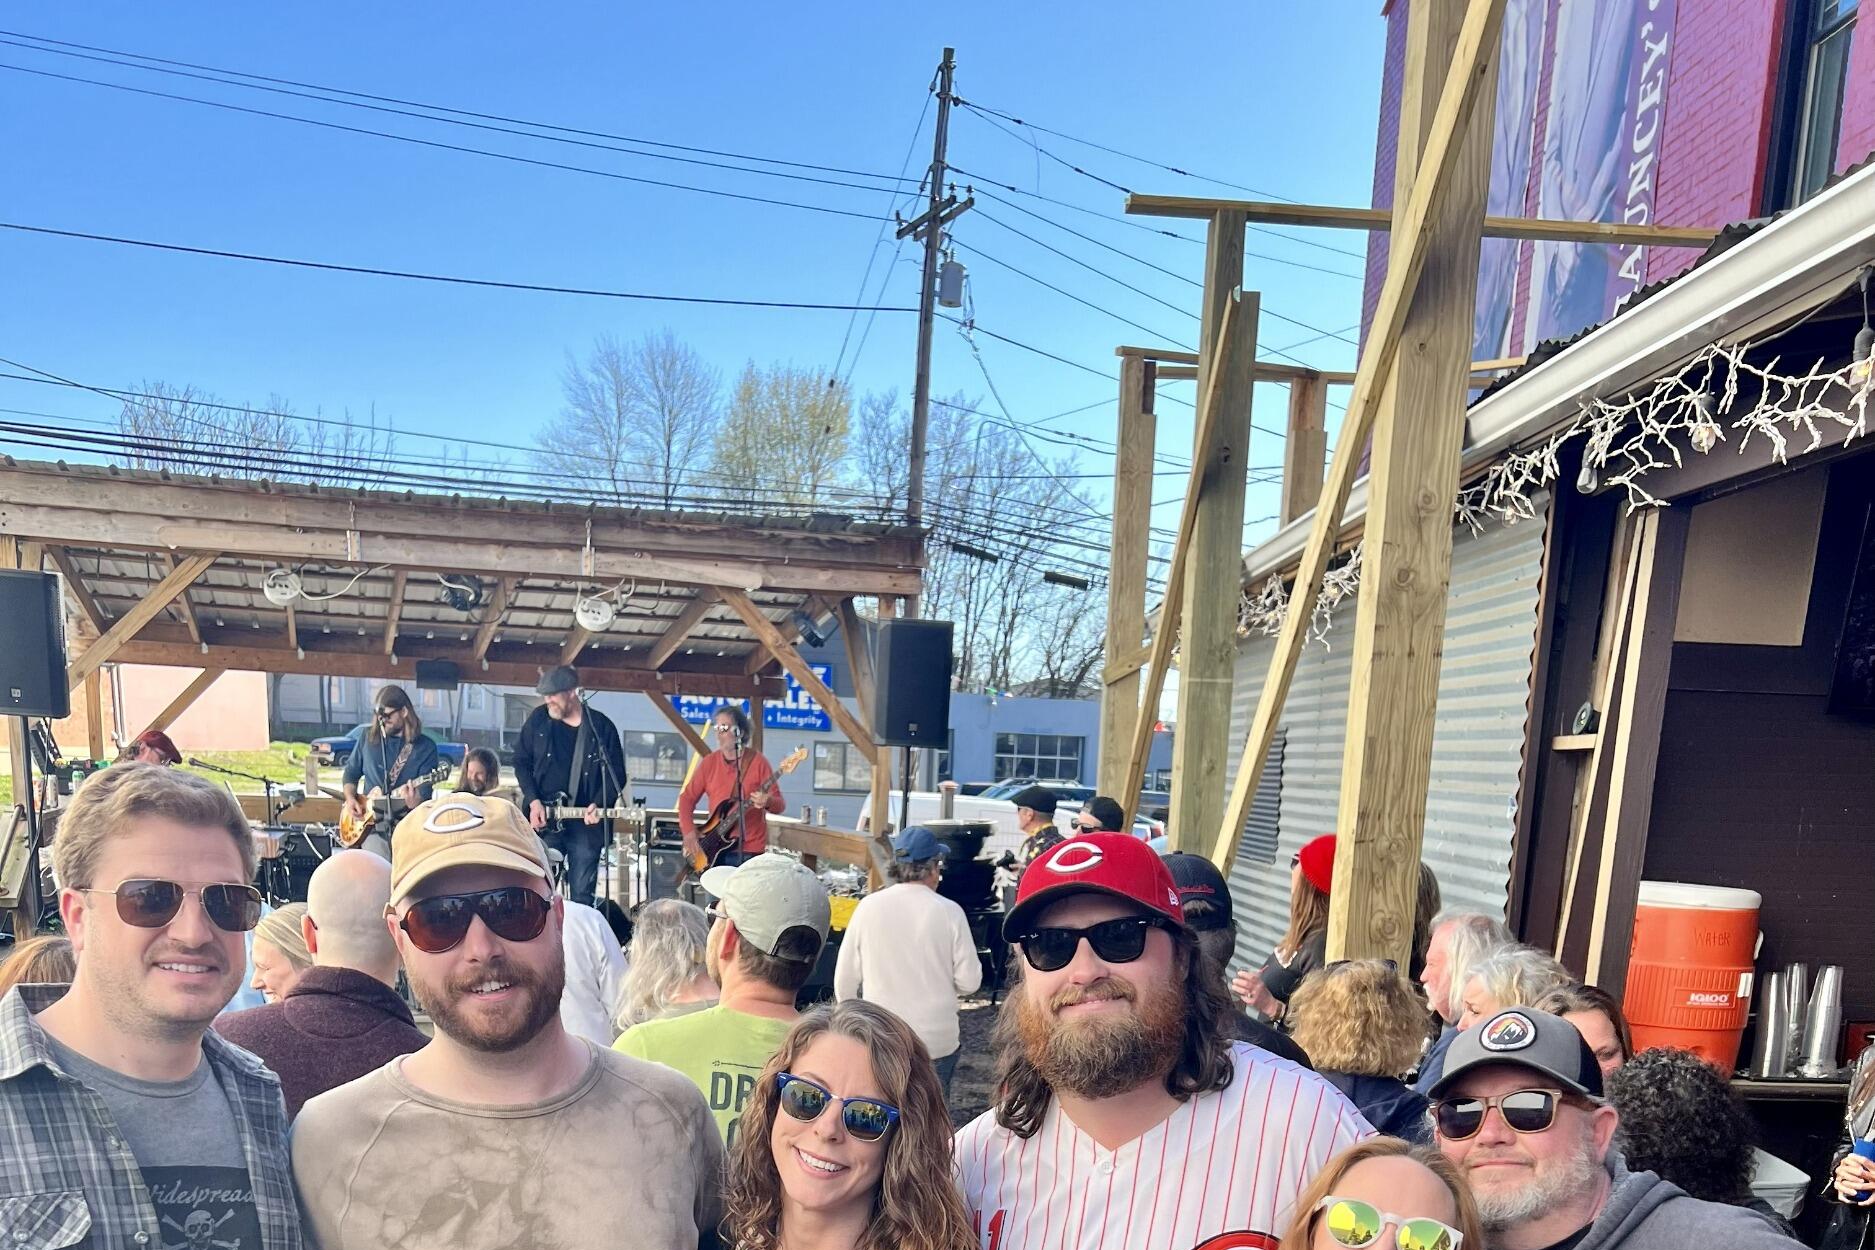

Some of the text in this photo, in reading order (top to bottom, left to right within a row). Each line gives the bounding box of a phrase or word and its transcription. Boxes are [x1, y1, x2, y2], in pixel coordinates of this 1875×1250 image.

[1613, 0, 1668, 318] AUNCEY'
[777, 711, 822, 727] Integrity
[150, 1179, 256, 1209] idesprea
